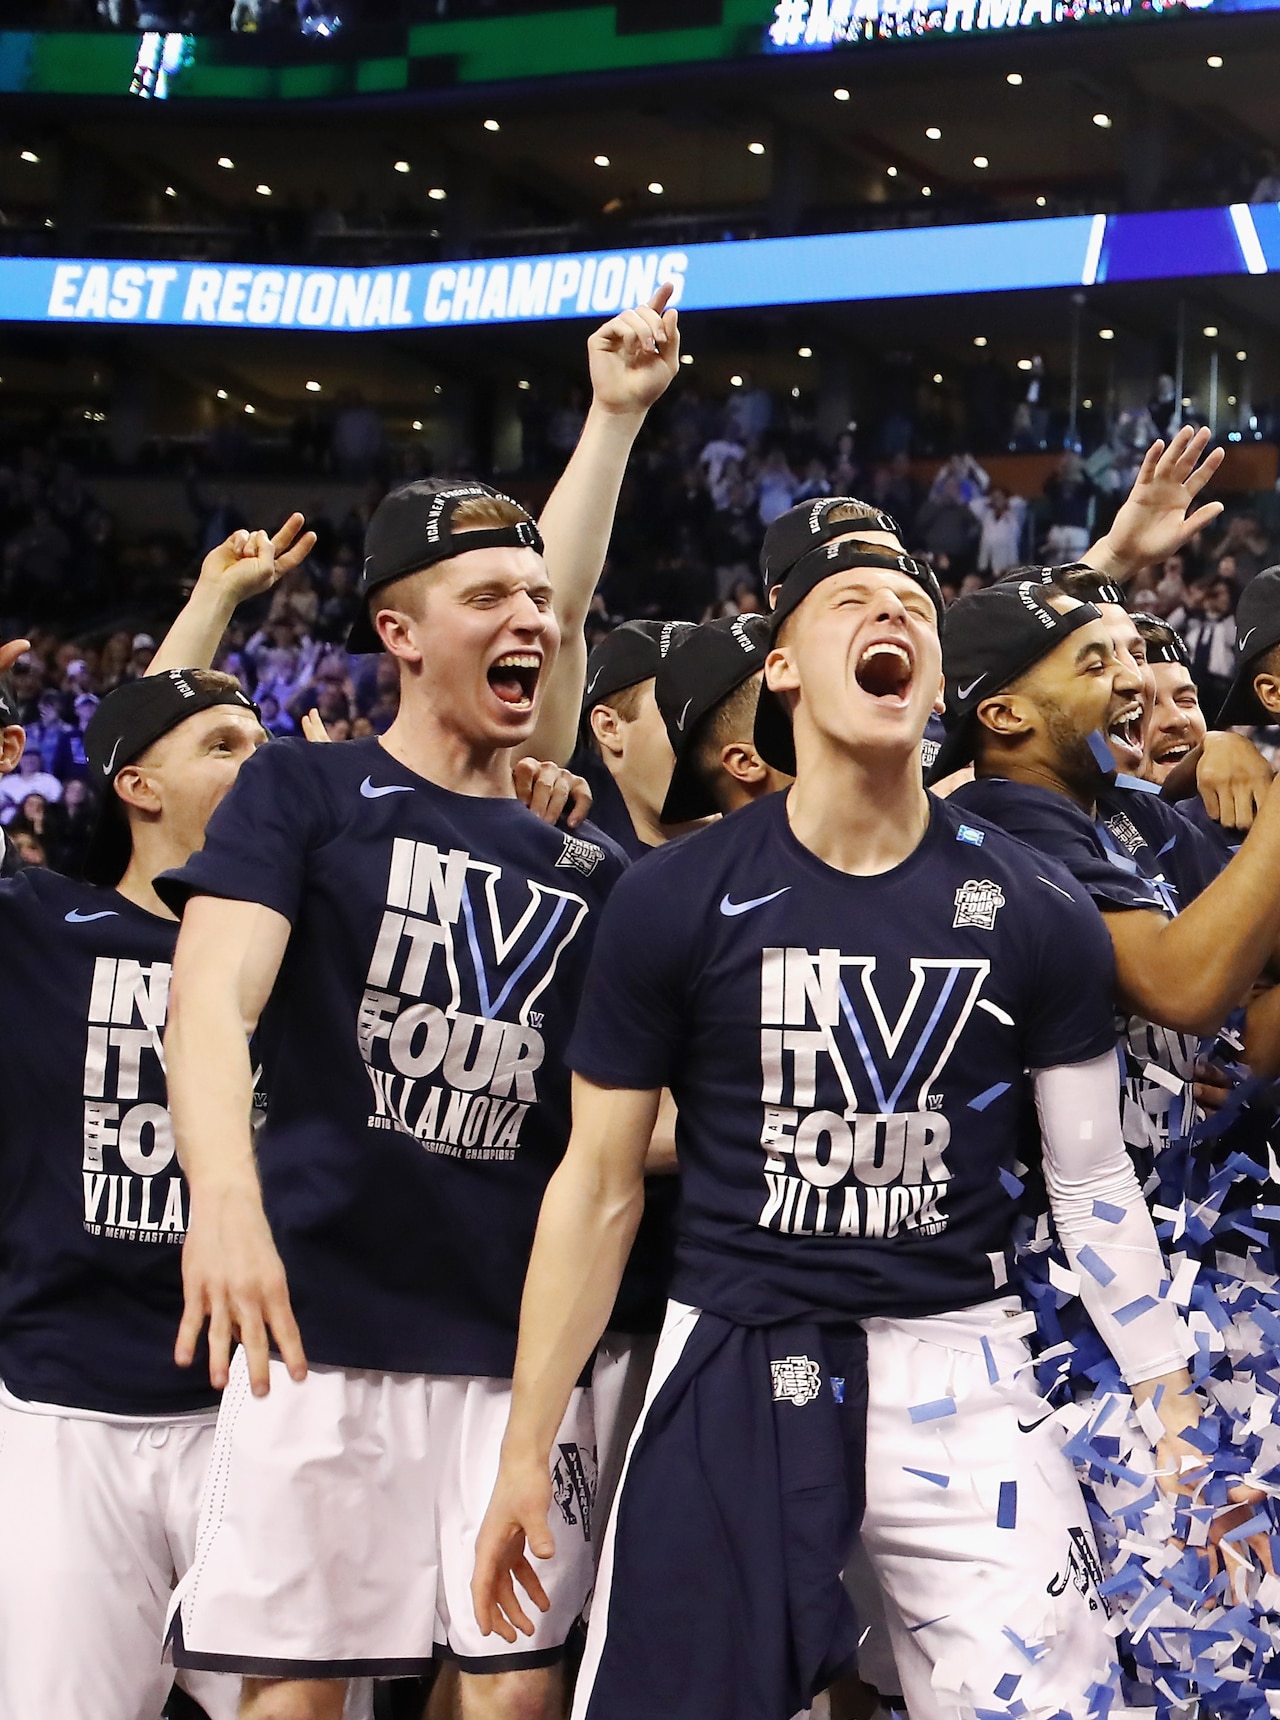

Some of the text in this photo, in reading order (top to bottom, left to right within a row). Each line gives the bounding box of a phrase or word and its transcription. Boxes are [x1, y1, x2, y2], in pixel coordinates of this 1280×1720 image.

[48, 252, 688, 328] EAST REGIONAL CHAMPIONS
[1034, 608, 1057, 629] NCAA
[386, 837, 470, 924] IN
[958, 891, 993, 903] FINAL
[960, 901, 994, 912] FOUR
[366, 911, 447, 997] IT
[761, 947, 841, 1026] IN
[88, 956, 172, 1026] IN
[83, 1025, 153, 1099] IT
[357, 988, 545, 1103] FOUR
[761, 1028, 828, 1107] IT
[82, 1100, 177, 1176] FO
[88, 1108, 101, 1161] FINAL
[365, 1063, 531, 1148] VILLANOVA
[367, 1116, 391, 1130] 2018
[465, 1148, 515, 1161] CHAMPIONS
[764, 1105, 952, 1187] FOUR
[82, 1172, 191, 1233] VILLA
[105, 1226, 136, 1241] MEN'S
[139, 1230, 164, 1244] EAST
[758, 1172, 949, 1239] VILLANOVA
[780, 1363, 798, 1396] FOUR
